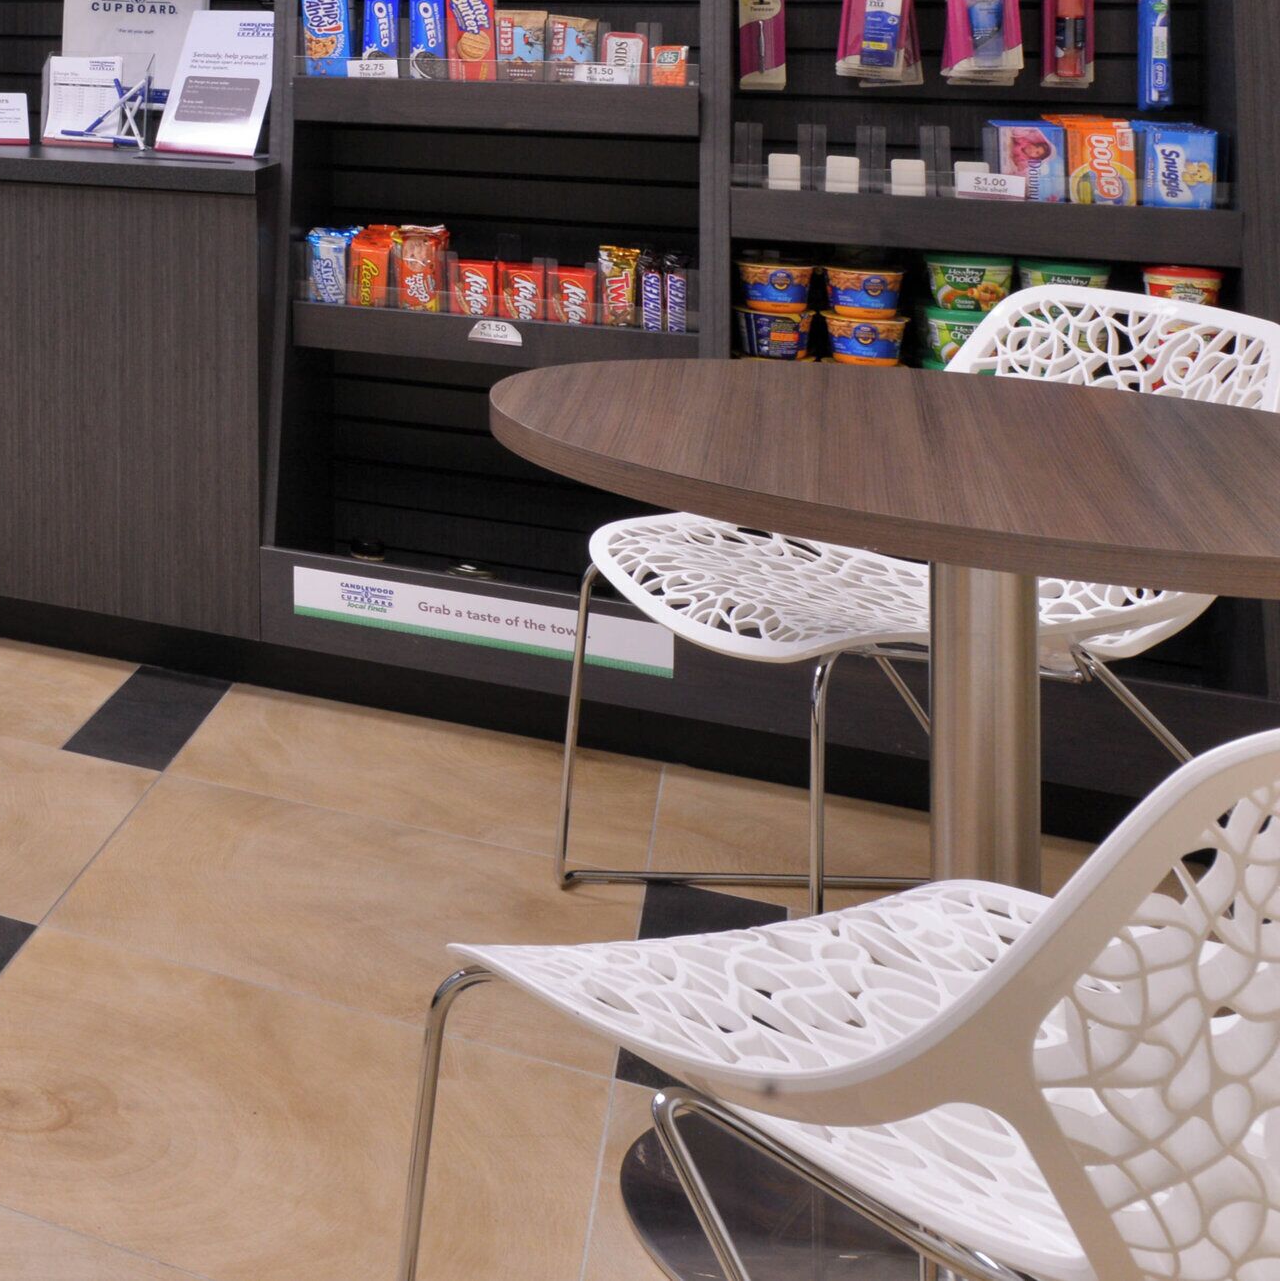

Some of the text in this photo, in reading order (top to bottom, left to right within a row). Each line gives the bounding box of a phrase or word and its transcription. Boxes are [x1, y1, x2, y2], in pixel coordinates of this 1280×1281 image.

[91, 2, 176, 15] CUPBOARD
[374, 1, 390, 48] OREO
[418, 1, 436, 48] OREO
[501, 20, 513, 47] CLIF
[554, 22, 566, 47] CLIF
[359, 63, 384, 71] $2.75
[587, 67, 614, 76] $1.50
[1090, 134, 1121, 198] bounce
[1160, 148, 1183, 199] Snuggle
[974, 176, 1007, 187] $1.00
[405, 275, 418, 297] Soft
[413, 273, 430, 303] Batch
[945, 274, 981, 284] Choice
[605, 276, 632, 326] TWIX
[643, 273, 661, 332] SNICKERS
[667, 275, 686, 333] SNICKERS
[480, 323, 507, 333] $1.50
[340, 581, 395, 596] CANDLEWOOD
[340, 594, 394, 608] CUPBOARD
[346, 601, 388, 614] local finds
[418, 600, 591, 639] Grab a taste of the tow.
